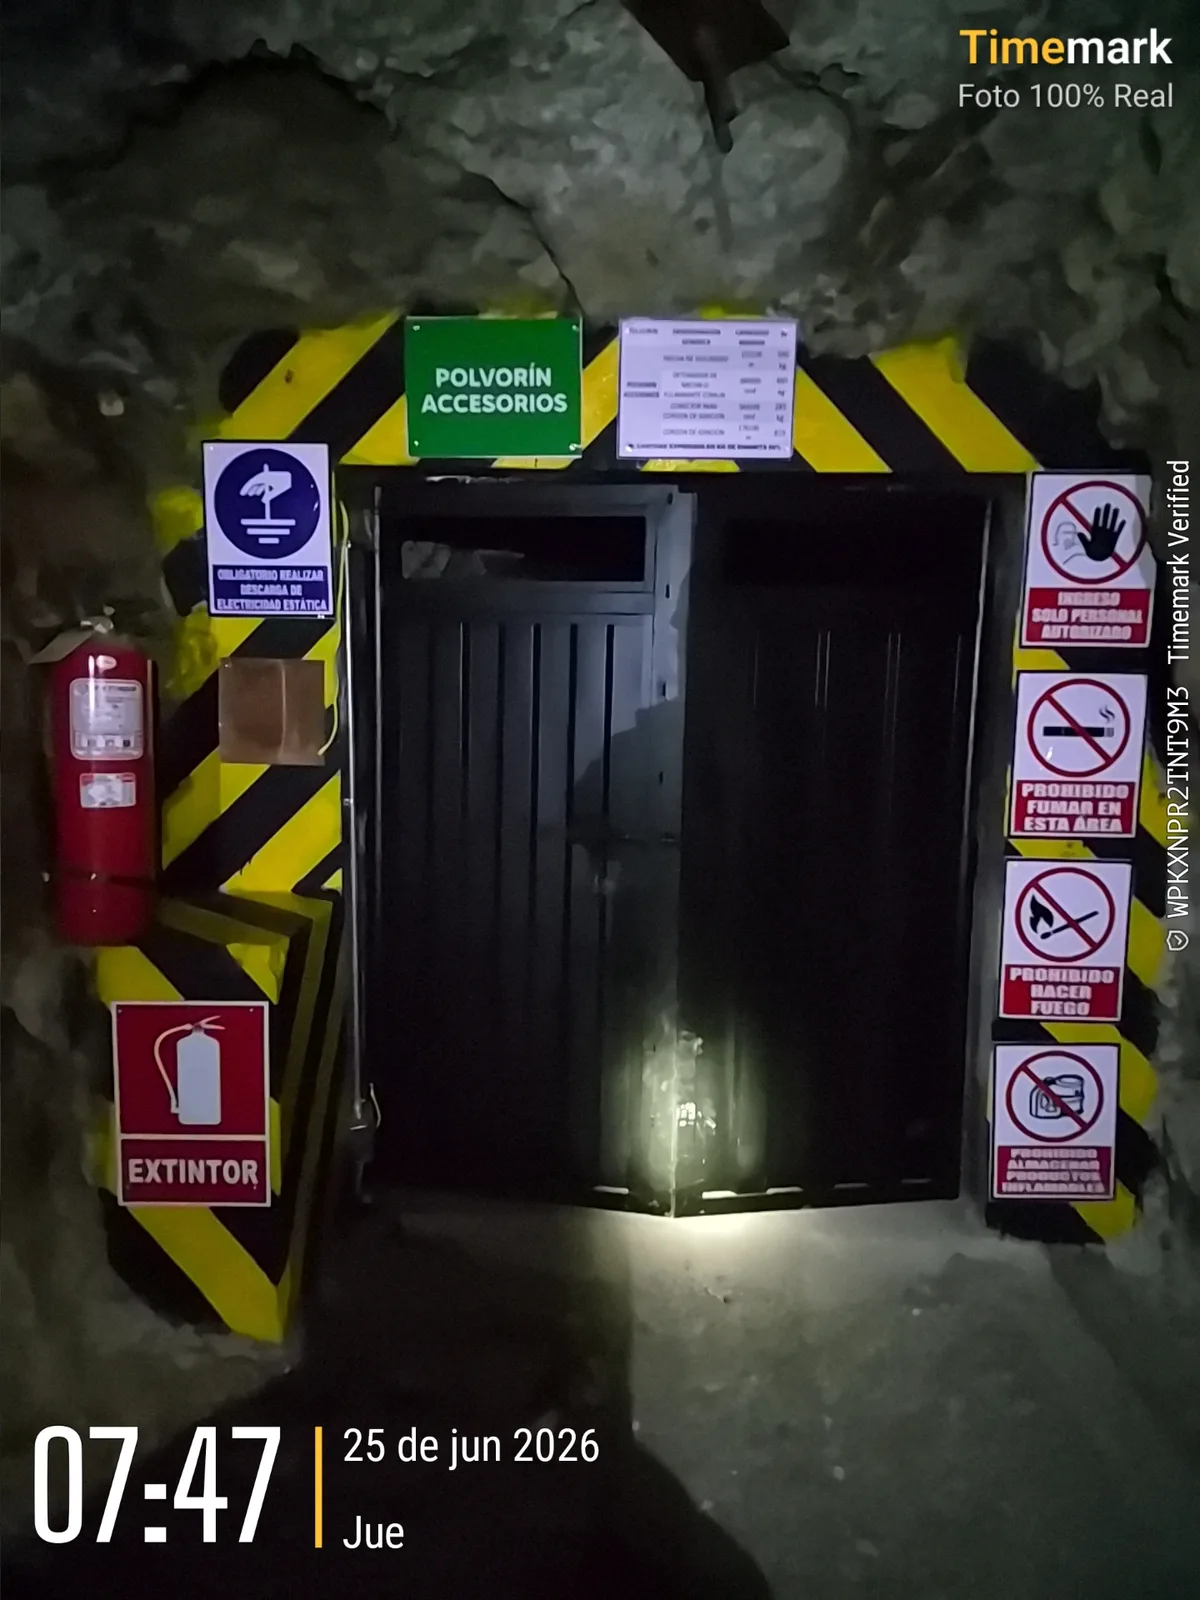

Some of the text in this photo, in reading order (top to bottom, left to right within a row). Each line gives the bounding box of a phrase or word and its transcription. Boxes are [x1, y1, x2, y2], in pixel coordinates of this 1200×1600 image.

[435, 362, 552, 388] POLVORÍN
[421, 393, 568, 414] ACCESORIOS
[217, 569, 324, 581] OBLIGATORIO REALIZAR
[240, 584, 302, 596] DESCARGA DE
[217, 598, 327, 611] ELECTRICIDAD ESTÁTICA
[1058, 591, 1121, 606] INGRESO
[1032, 608, 1143, 623] SOLO PERSONAL
[1041, 624, 1132, 640] AUTORIZADO
[1022, 783, 1129, 799] PROHIBIDO
[1027, 800, 1121, 816] FUMAR EN
[1024, 816, 1123, 832] ESTA ÁREA
[1010, 967, 1115, 984] PROHIBIDO
[1030, 984, 1092, 999] HACER
[1031, 1000, 1090, 1015] FUEGO
[128, 1158, 259, 1185] EXTINTOR
